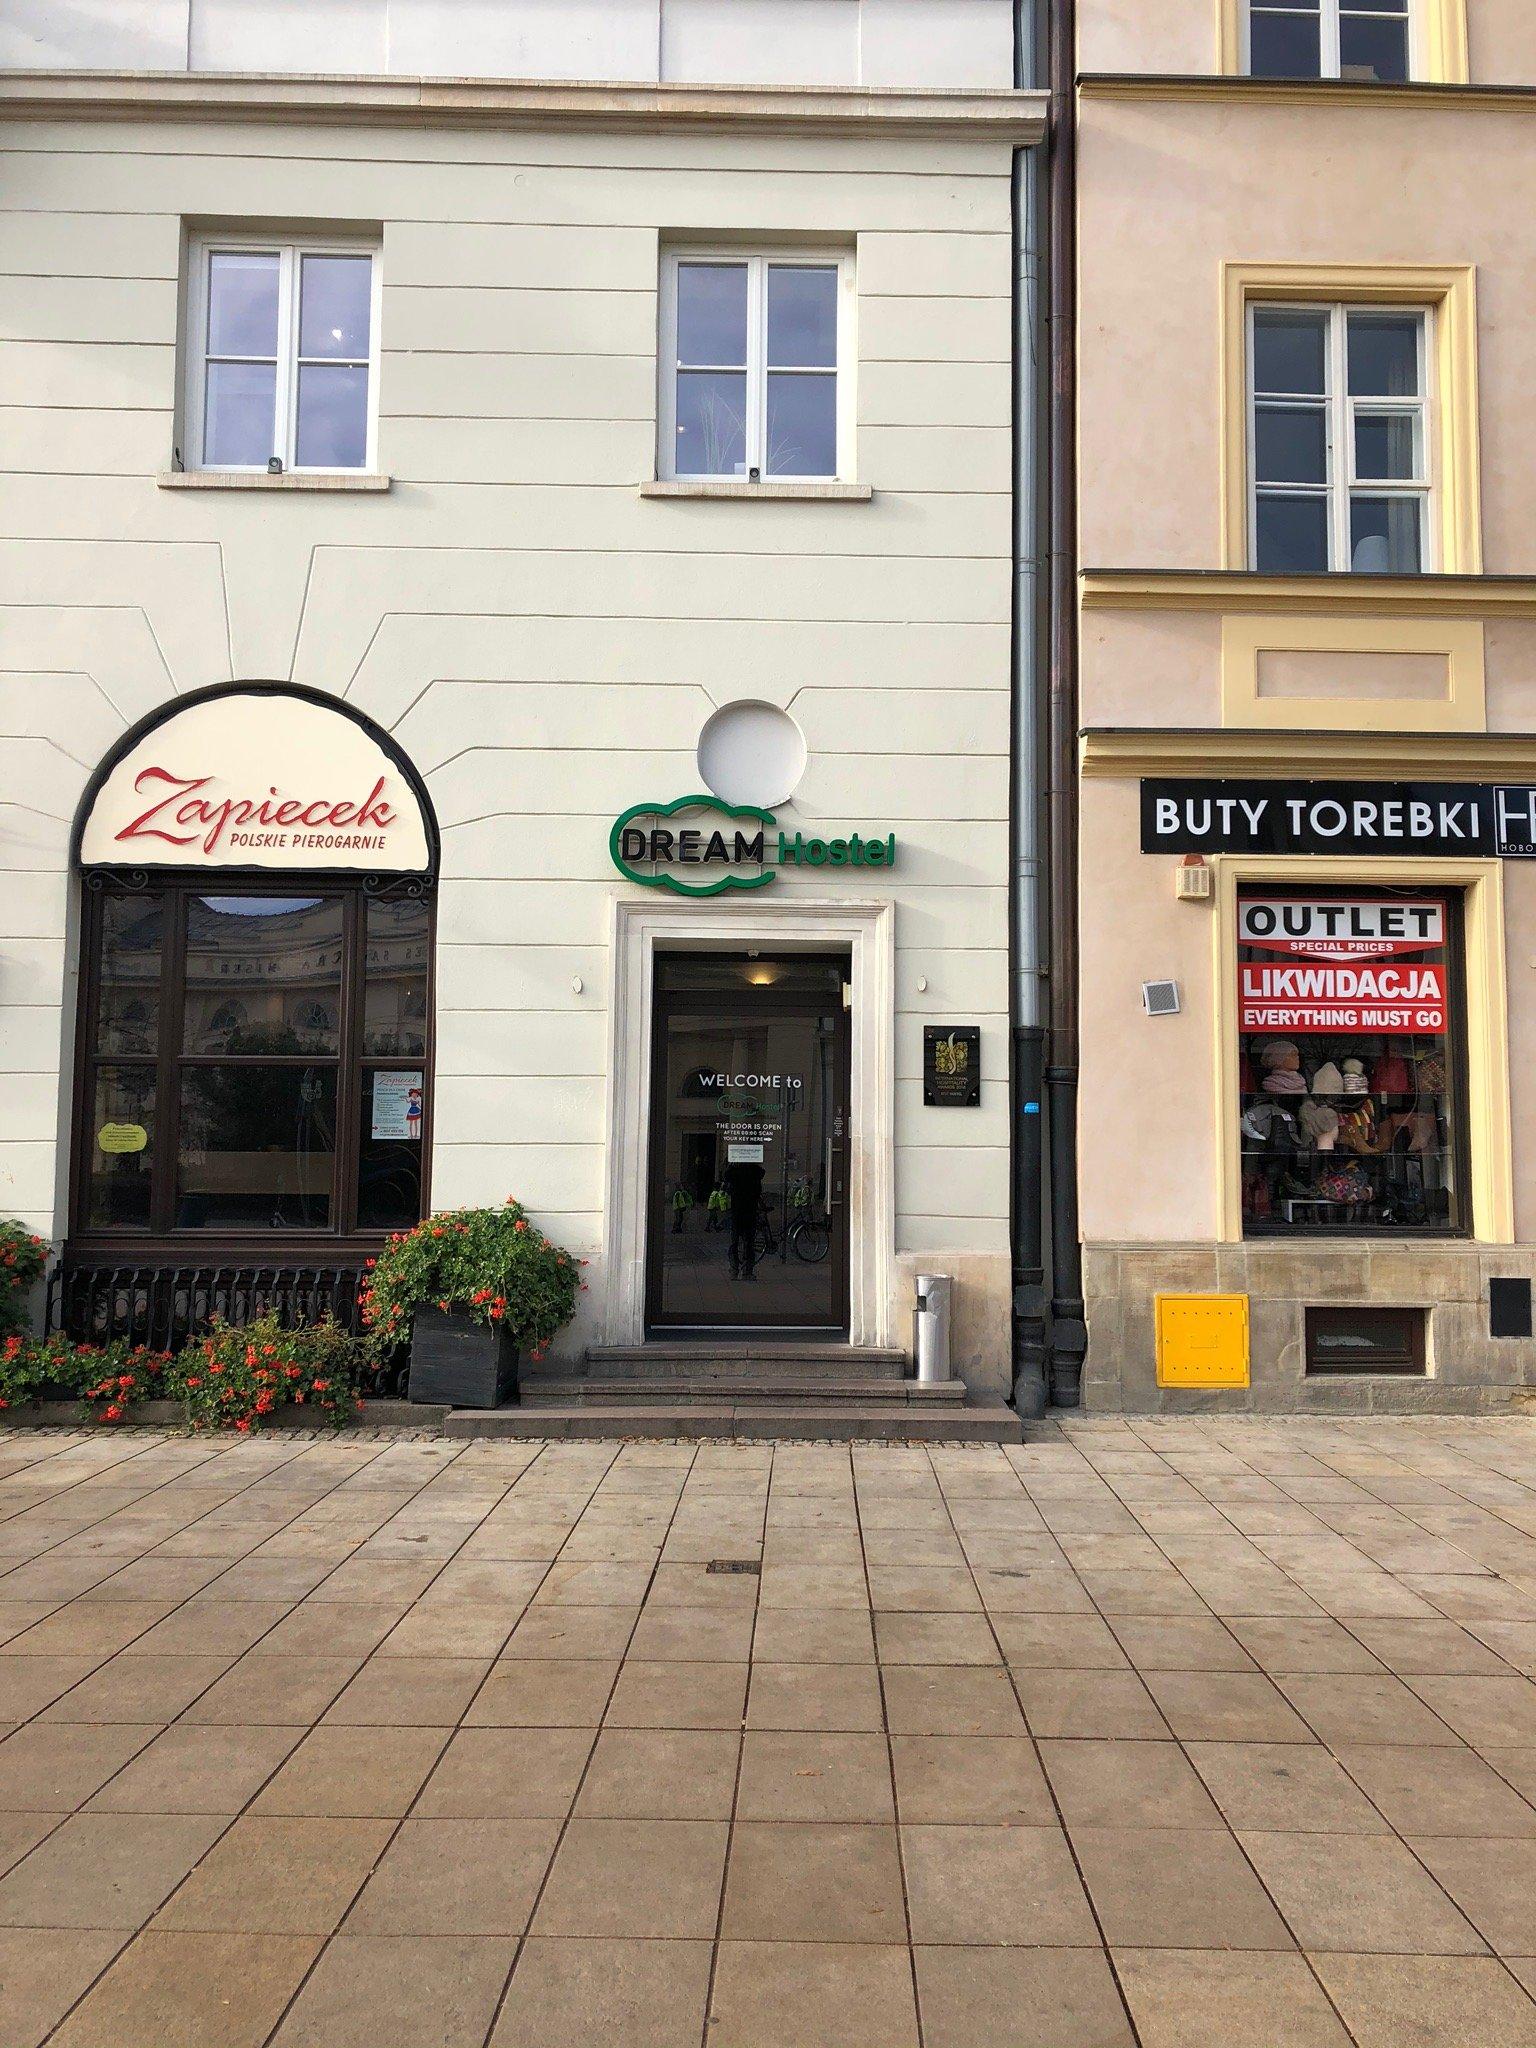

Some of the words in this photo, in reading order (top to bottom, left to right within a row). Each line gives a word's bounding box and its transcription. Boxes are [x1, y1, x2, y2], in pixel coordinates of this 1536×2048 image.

[114, 766, 397, 855] Zapiecek
[1155, 798, 1268, 836] BUTY
[1286, 799, 1480, 838] TOREBKI
[230, 833, 286, 848] POLSKIE
[292, 834, 387, 850] PIEROGARNIE
[621, 828, 764, 863] DREAM
[778, 831, 895, 866] Hostel
[1501, 844, 1534, 852] HOBO
[1245, 905, 1438, 937] OUTLET
[1289, 941, 1345, 952] SPECIAL
[1347, 942, 1394, 952] PRICES
[1243, 968, 1442, 999] LIKWIDACJA
[1244, 1009, 1358, 1026] EVERYTHING
[1361, 1010, 1411, 1027] MUST
[1416, 1010, 1443, 1027] GO
[699, 1073, 781, 1088] WELCOME
[786, 1075, 802, 1088] to
[731, 1122, 752, 1130] DOOR
[762, 1123, 782, 1131] OPEN
